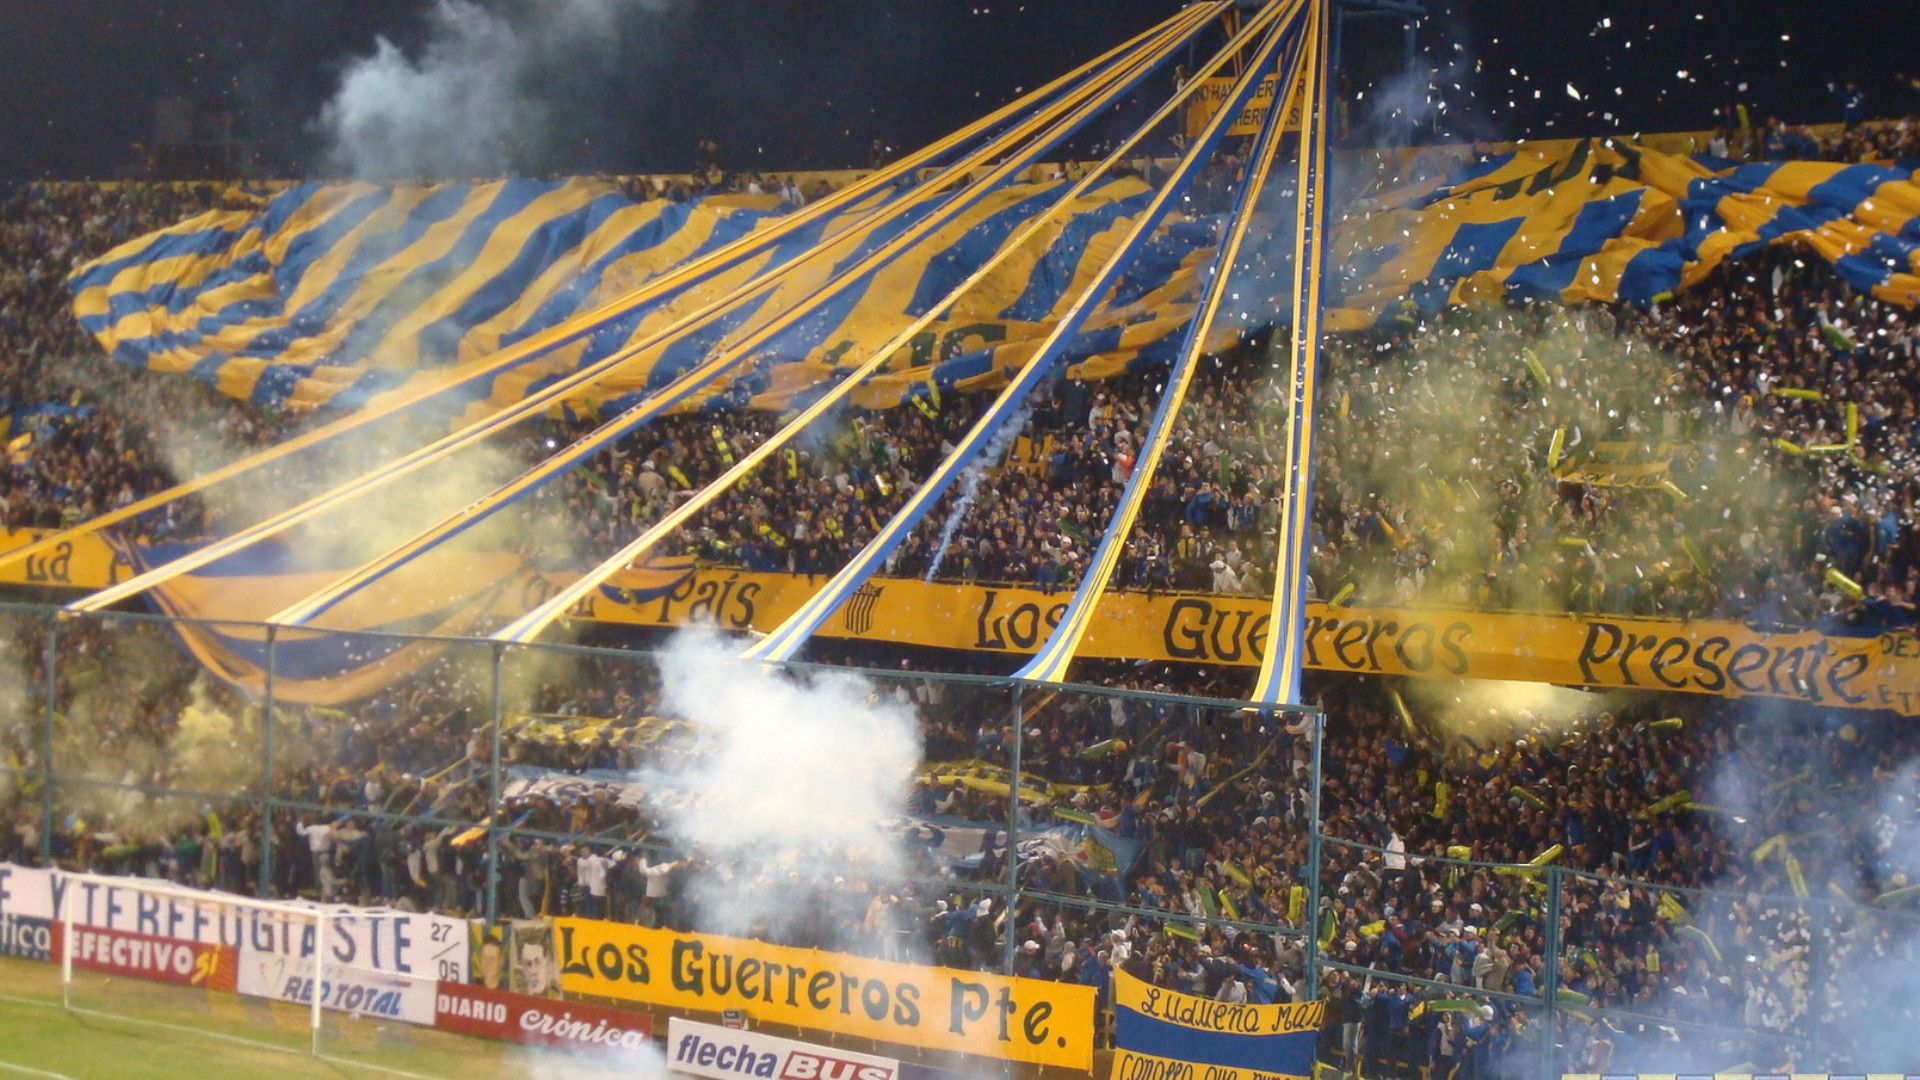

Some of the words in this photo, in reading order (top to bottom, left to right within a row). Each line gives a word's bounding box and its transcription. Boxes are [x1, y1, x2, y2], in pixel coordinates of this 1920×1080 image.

[1579, 622, 1868, 704] Presente
[71, 930, 194, 975] EFECTIVO
[332, 983, 402, 1016] TOTAL
[437, 994, 507, 1024] DIARIO
[560, 926, 650, 986] Los
[671, 939, 921, 1027] Guerreros
[949, 977, 1067, 1049] Pte.
[676, 1034, 777, 1078] flecha
[783, 1053, 888, 1080] BUS
